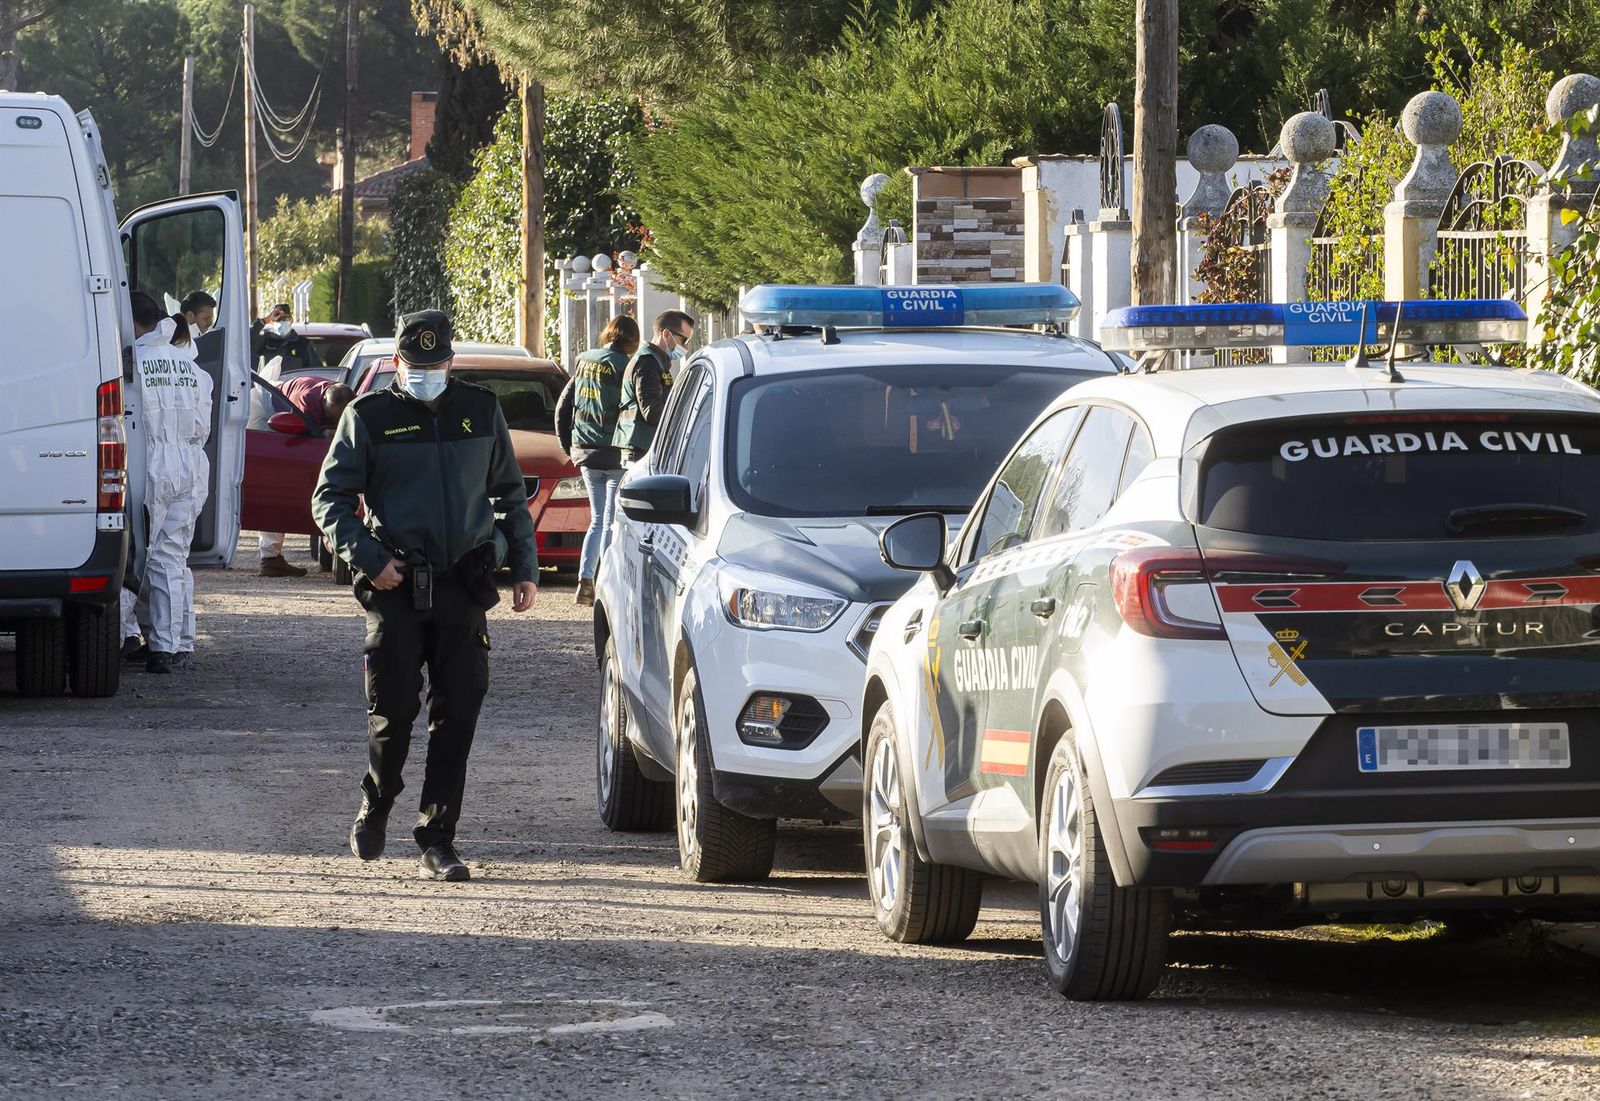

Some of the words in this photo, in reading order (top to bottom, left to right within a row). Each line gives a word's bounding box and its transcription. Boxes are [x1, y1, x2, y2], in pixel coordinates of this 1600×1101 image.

[887, 290, 957, 299] GUARDIA
[902, 300, 944, 311] CIVIL
[1289, 302, 1366, 314] GUARDIA
[1308, 312, 1352, 323] CIVIL
[384, 427, 408, 436] GUARDIA
[1280, 431, 1469, 462] GUARDIA
[1479, 431, 1582, 455] CIVIL
[1384, 621, 1544, 636] CAPTUR
[954, 648, 1008, 692] GUARDIA
[1011, 645, 1038, 691] CIVIL
[1364, 753, 1372, 764] E
